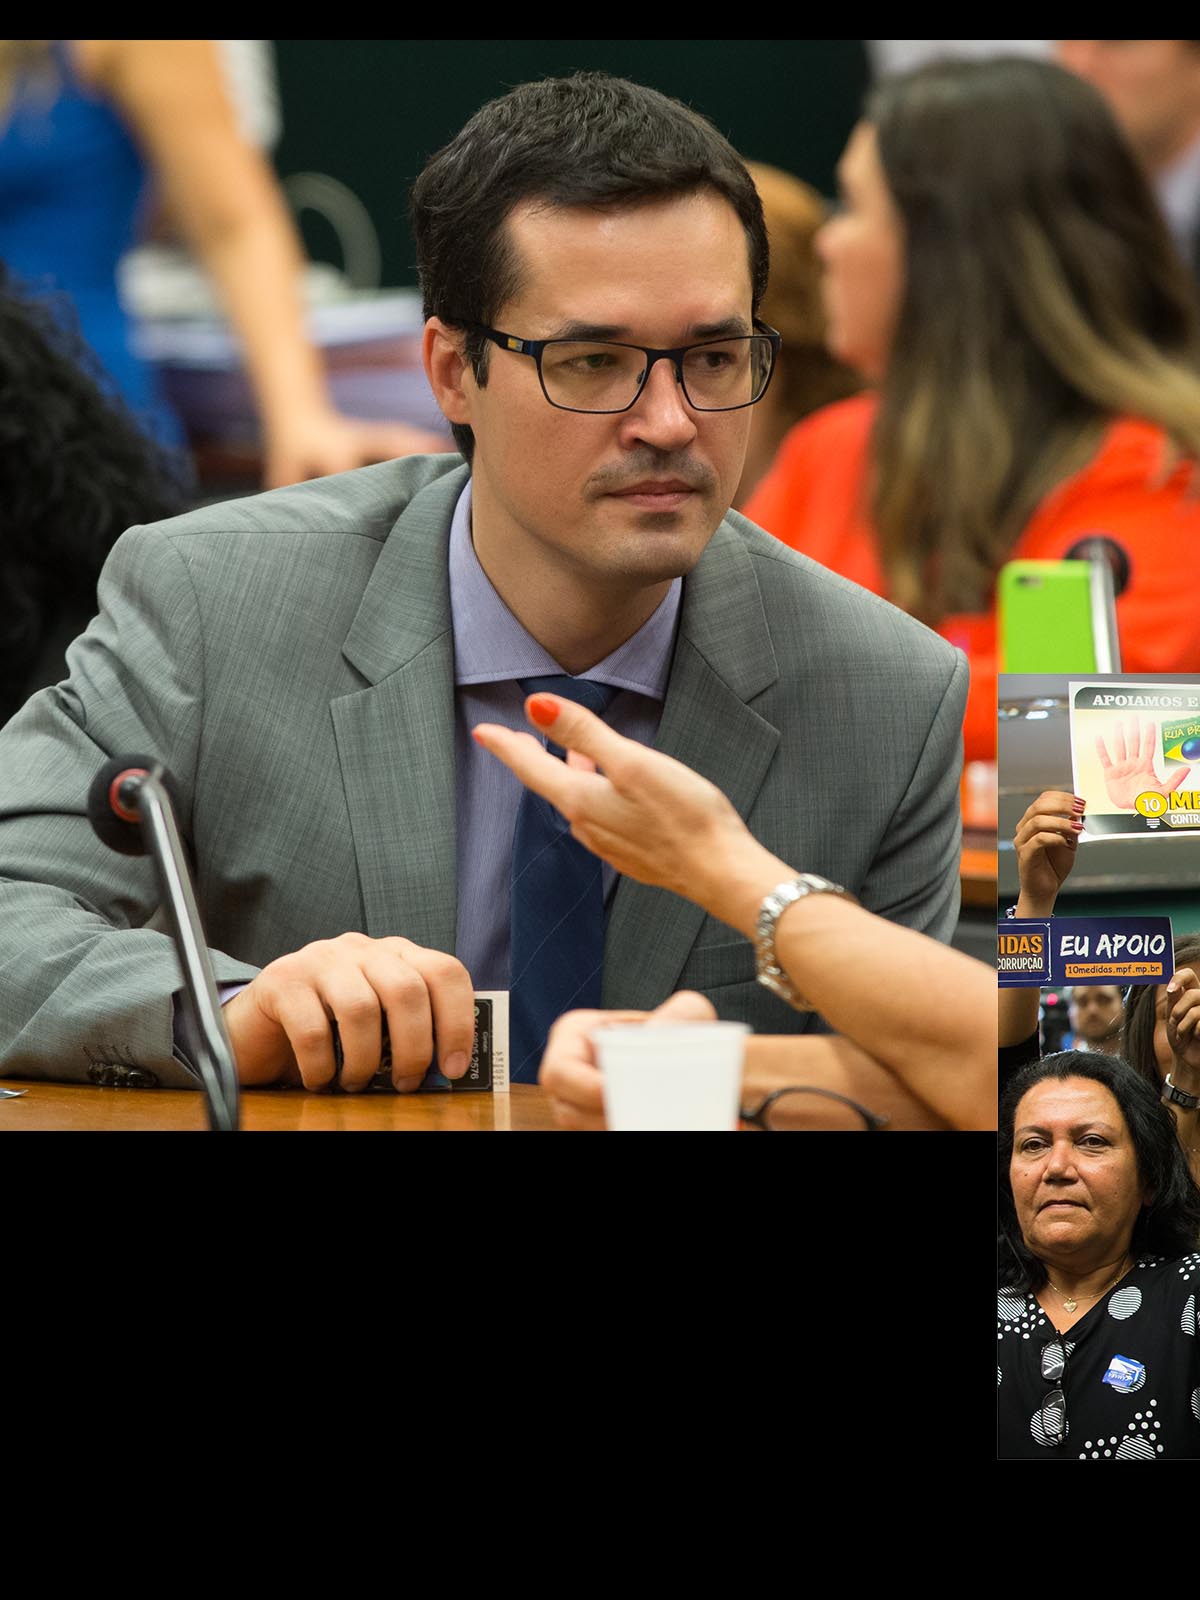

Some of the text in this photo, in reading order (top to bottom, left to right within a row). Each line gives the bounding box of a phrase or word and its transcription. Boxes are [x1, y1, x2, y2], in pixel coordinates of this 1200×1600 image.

[1093, 695, 1182, 707] APOIAMOS
[1188, 696, 1200, 707] E
[1164, 728, 1185, 741] RUA
[1142, 798, 1161, 812] 10
[998, 935, 1043, 954] IDAS
[1060, 934, 1166, 959] EU APOIO
[1068, 964, 1160, 975] 10medidas.mpf.mp.br
